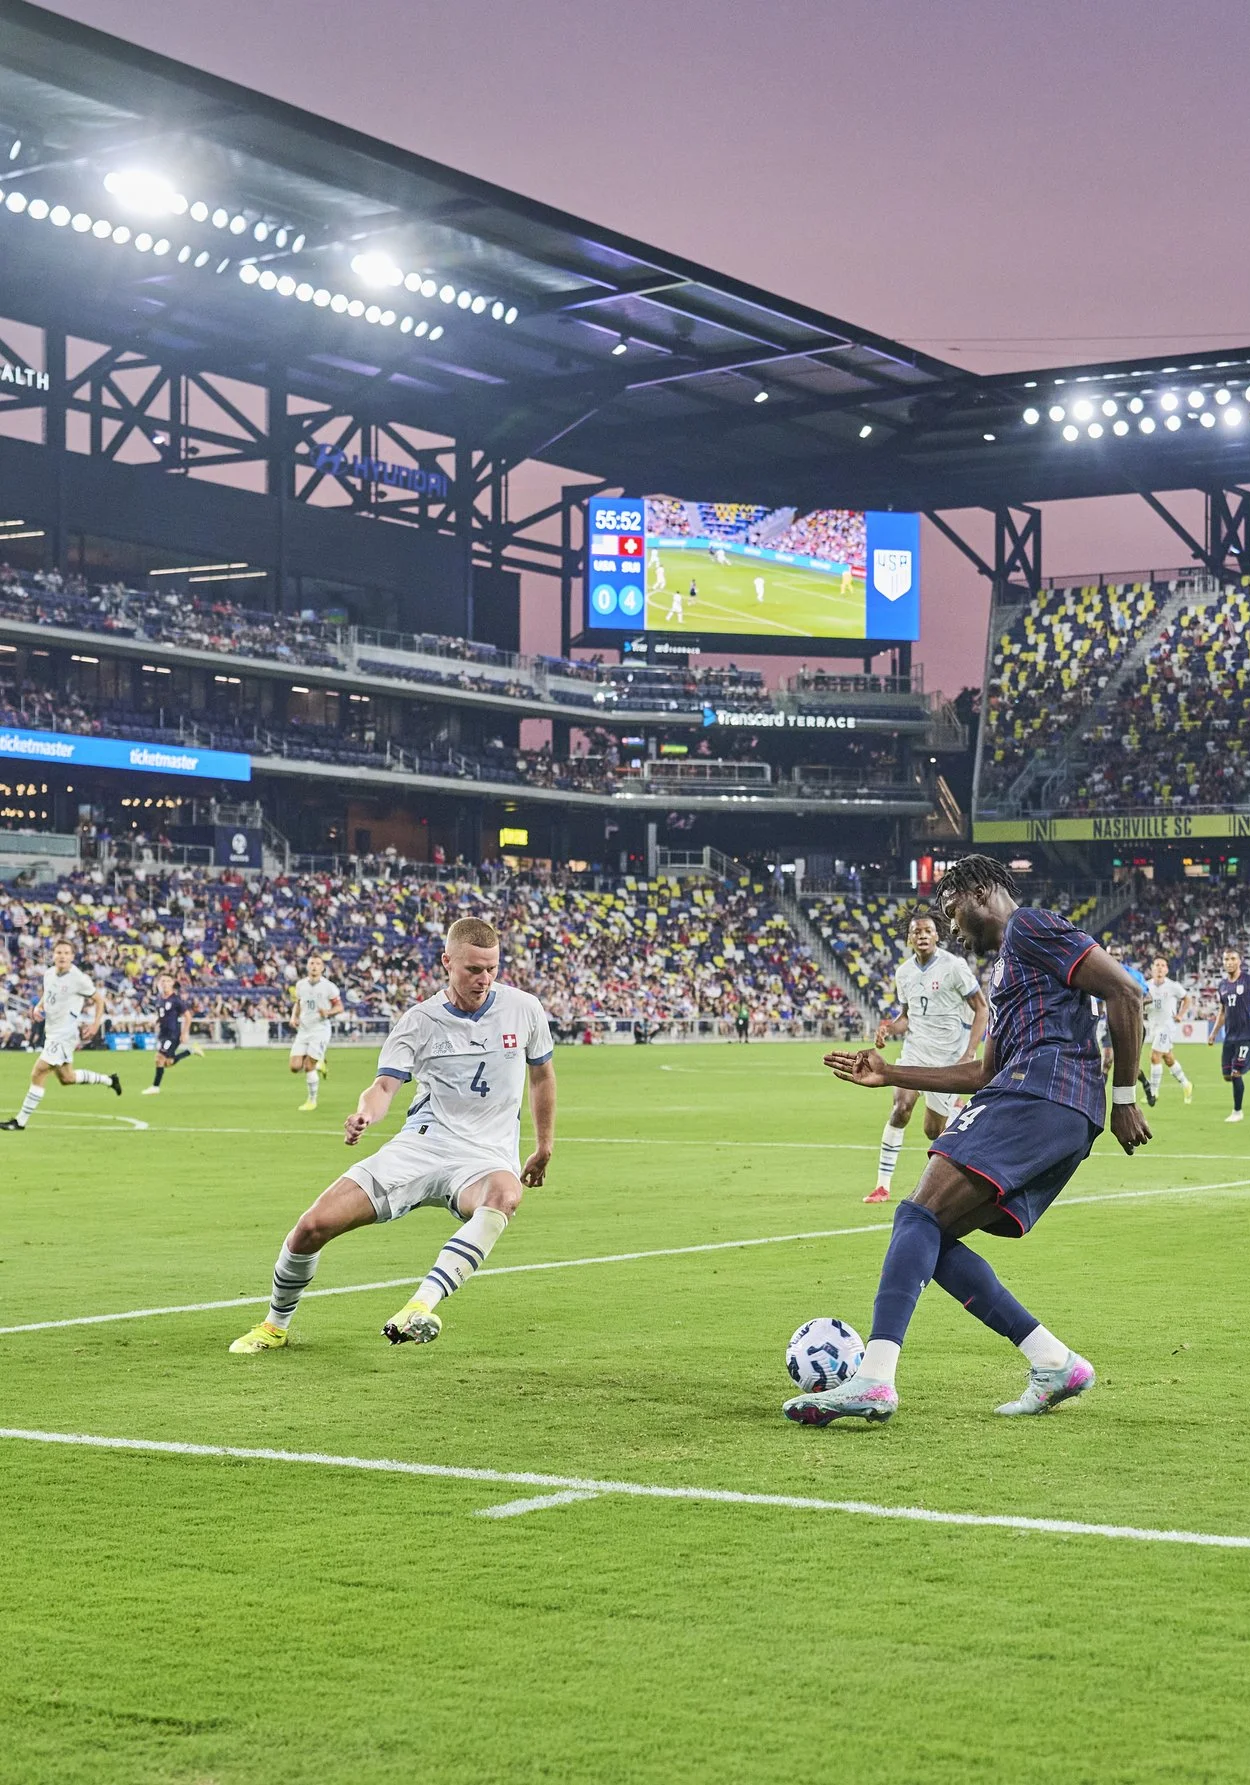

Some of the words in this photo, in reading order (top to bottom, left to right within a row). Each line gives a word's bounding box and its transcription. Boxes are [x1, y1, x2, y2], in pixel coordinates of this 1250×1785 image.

[0, 363, 49, 391] ALTH
[352, 454, 447, 498] HYUNDAI
[595, 509, 641, 531] 55:52
[593, 560, 616, 572] USA
[621, 561, 641, 573] SUI
[598, 589, 610, 610] 0
[623, 589, 636, 610] 4
[716, 710, 784, 727] Transcard
[786, 716, 856, 729] TERRACE
[0, 733, 74, 758] ticketmaster
[130, 747, 198, 770] ticketmaster
[1093, 817, 1169, 838] NASHVILLE
[1174, 816, 1192, 836] SC
[307, 1000, 315, 1010] 10
[920, 996, 928, 1016] 9
[1227, 995, 1237, 1007] 17
[1239, 1046, 1249, 1059] 17
[470, 1061, 491, 1098] 4
[957, 1100, 987, 1131] 4
